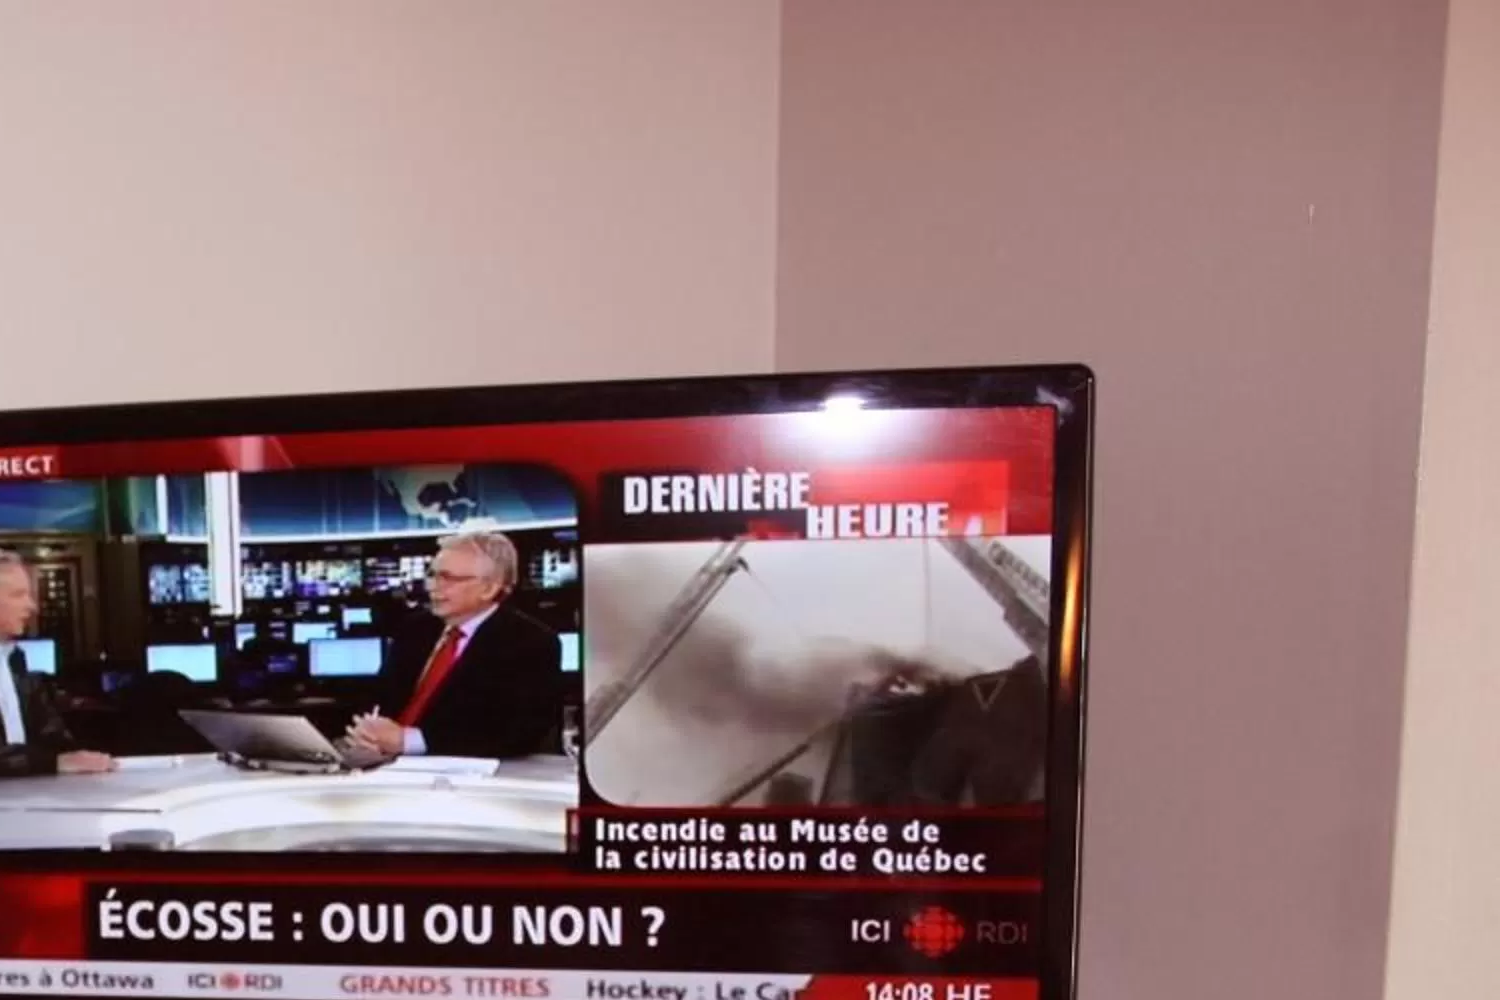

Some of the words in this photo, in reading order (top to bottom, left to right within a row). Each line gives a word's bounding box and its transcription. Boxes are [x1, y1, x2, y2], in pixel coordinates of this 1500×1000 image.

[622, 467, 811, 516] DERNIÈRE
[805, 502, 949, 539] HEURE
[595, 817, 726, 843] Incendie
[738, 820, 777, 844] au
[790, 816, 889, 845] Musée
[902, 819, 940, 843] de
[595, 847, 621, 870] la
[634, 845, 807, 872] civilisation
[819, 848, 857, 873] de
[872, 846, 987, 875] Québec
[99, 887, 275, 942] ÉCOSSE
[291, 909, 304, 942] :
[320, 902, 405, 944] OUI
[423, 904, 494, 945] OU
[512, 904, 623, 947] NON
[640, 905, 666, 947] ?
[851, 918, 891, 944] ICI
[975, 919, 1029, 946] RDI
[38, 967, 53, 988] à
[60, 967, 156, 990] Ottawa
[186, 973, 217, 990] ICI
[243, 974, 283, 992] RDI
[338, 973, 453, 996] GRANDS
[462, 976, 552, 999] TITRES
